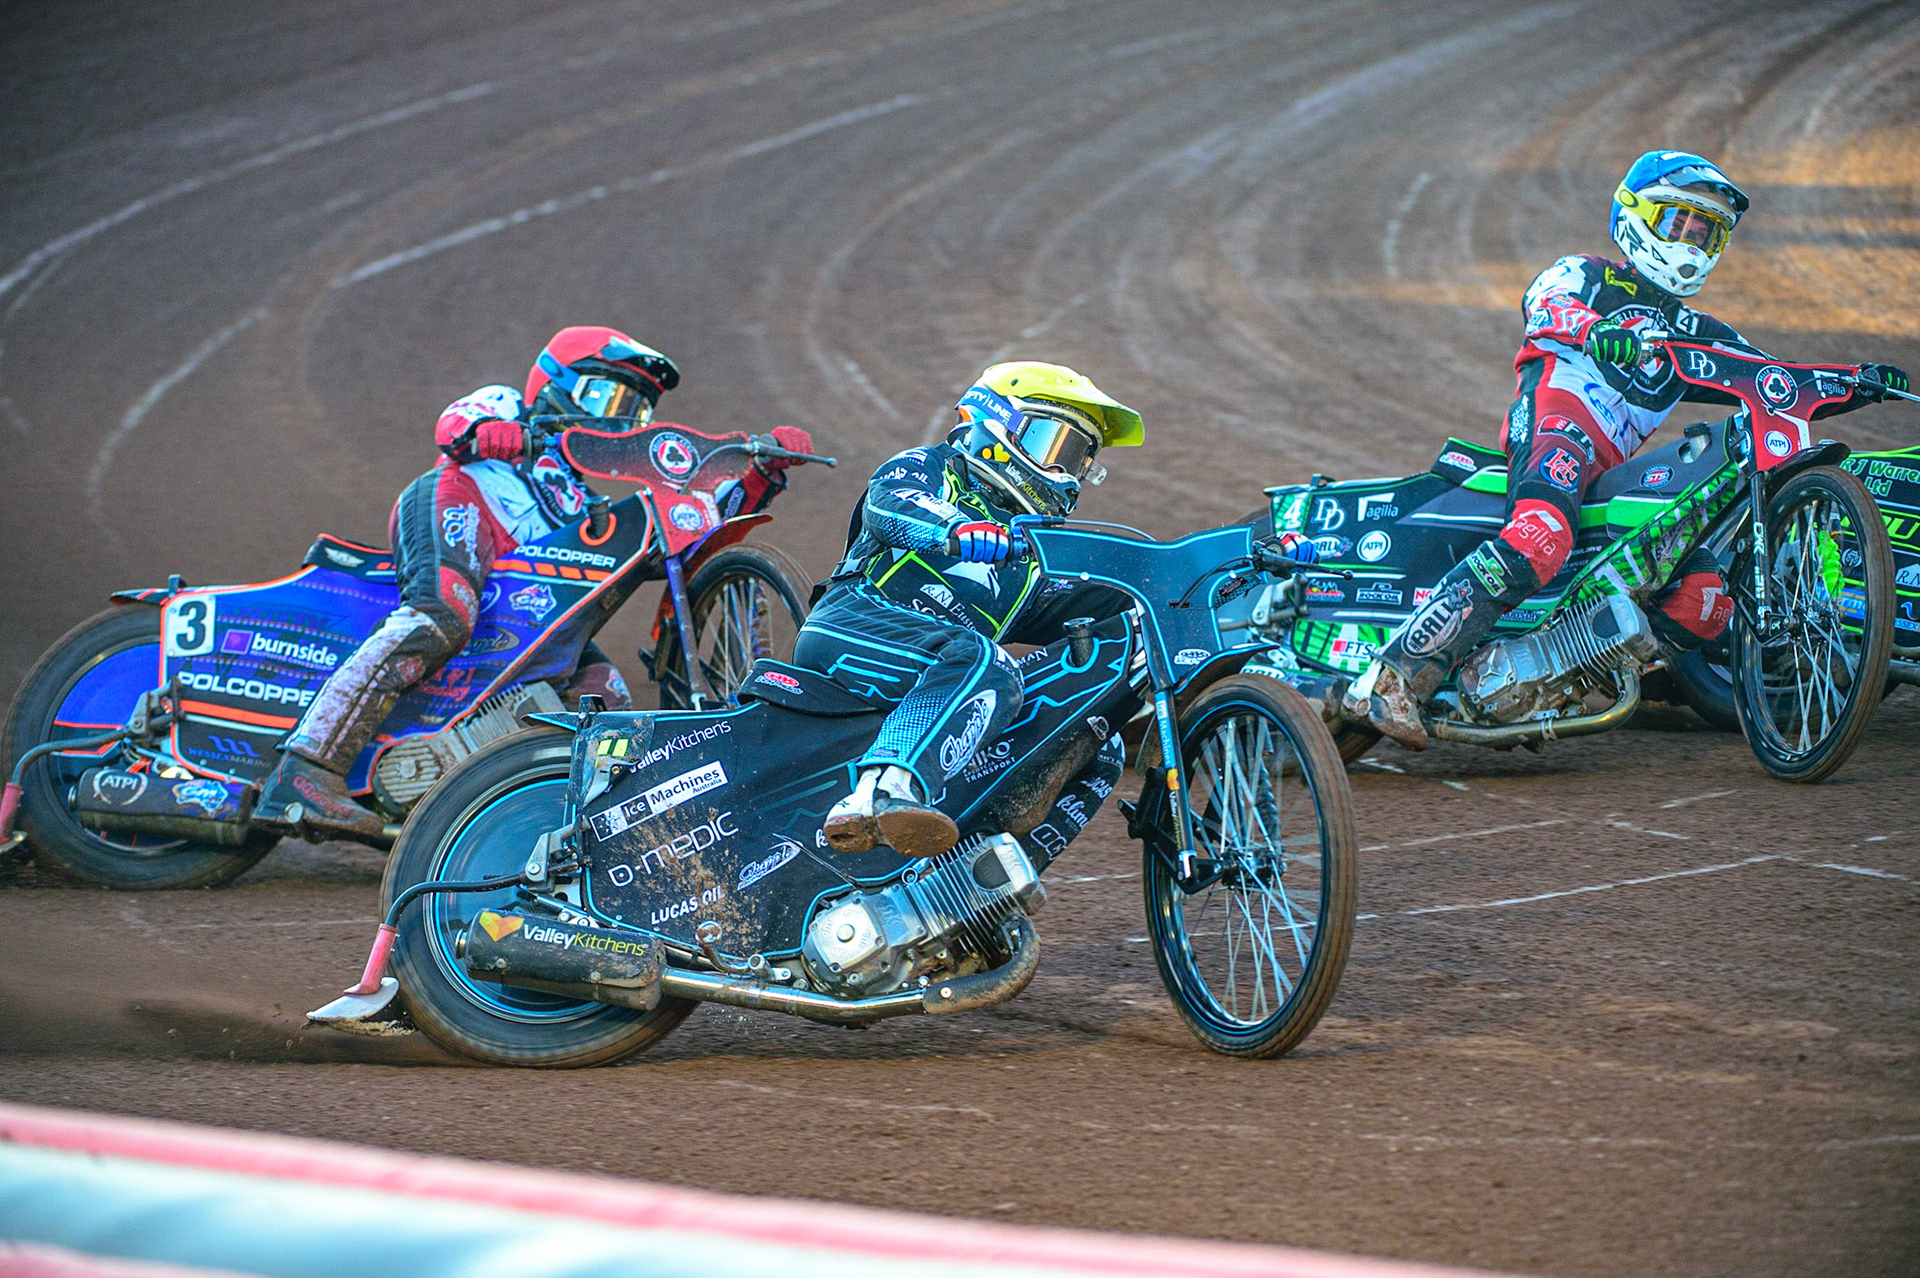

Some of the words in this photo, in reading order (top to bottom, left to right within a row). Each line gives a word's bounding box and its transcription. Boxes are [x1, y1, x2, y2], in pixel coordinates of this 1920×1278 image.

[1679, 313, 1694, 334] 4
[1821, 380, 1847, 396] agilia
[1769, 438, 1787, 449] ATPI
[1868, 460, 1920, 486] Warre
[1865, 476, 1893, 497] Ltd
[1282, 497, 1303, 530] 4
[1366, 503, 1399, 520] agilia
[1363, 541, 1384, 551] ATPI
[1514, 517, 1557, 557] agilia
[513, 544, 617, 569] POLCOPPER
[175, 600, 208, 650] 3
[251, 632, 338, 666] burnside
[177, 670, 316, 707] POLCOPPE
[101, 774, 138, 791] ATPI
[965, 756, 1016, 784] TRANSPORT
[623, 799, 648, 819] Ice
[650, 768, 721, 806] Machines
[692, 778, 723, 795] Australia
[650, 896, 699, 926] LUCAS
[702, 884, 726, 907] OIL
[523, 923, 645, 957] ValleyKitchens
